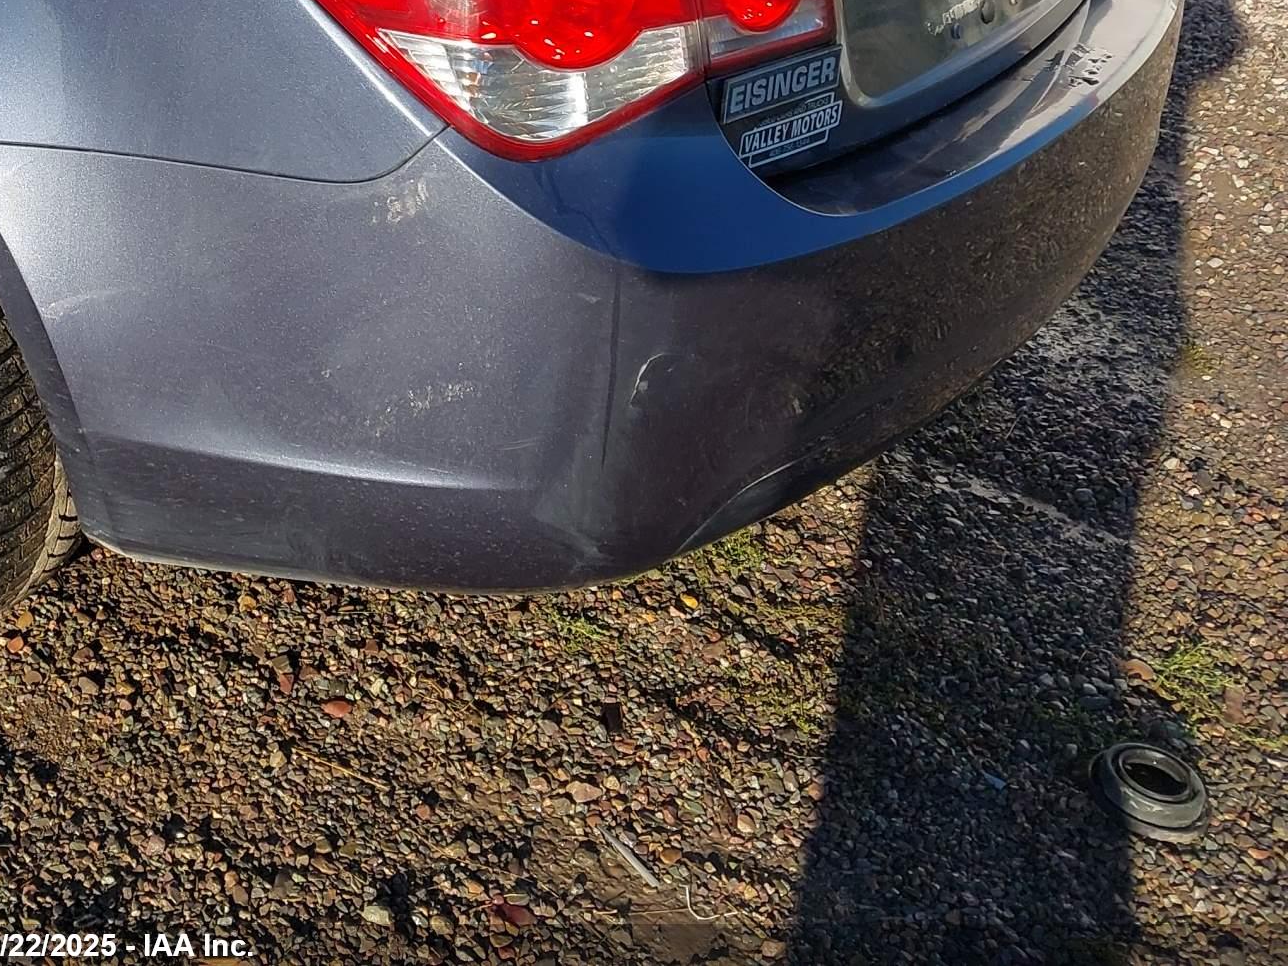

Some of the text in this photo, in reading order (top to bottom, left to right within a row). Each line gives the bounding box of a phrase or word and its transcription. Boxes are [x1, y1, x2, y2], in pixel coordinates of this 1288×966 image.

[729, 56, 836, 114] EISINGER
[744, 105, 838, 153] VALLEY MOTORS
